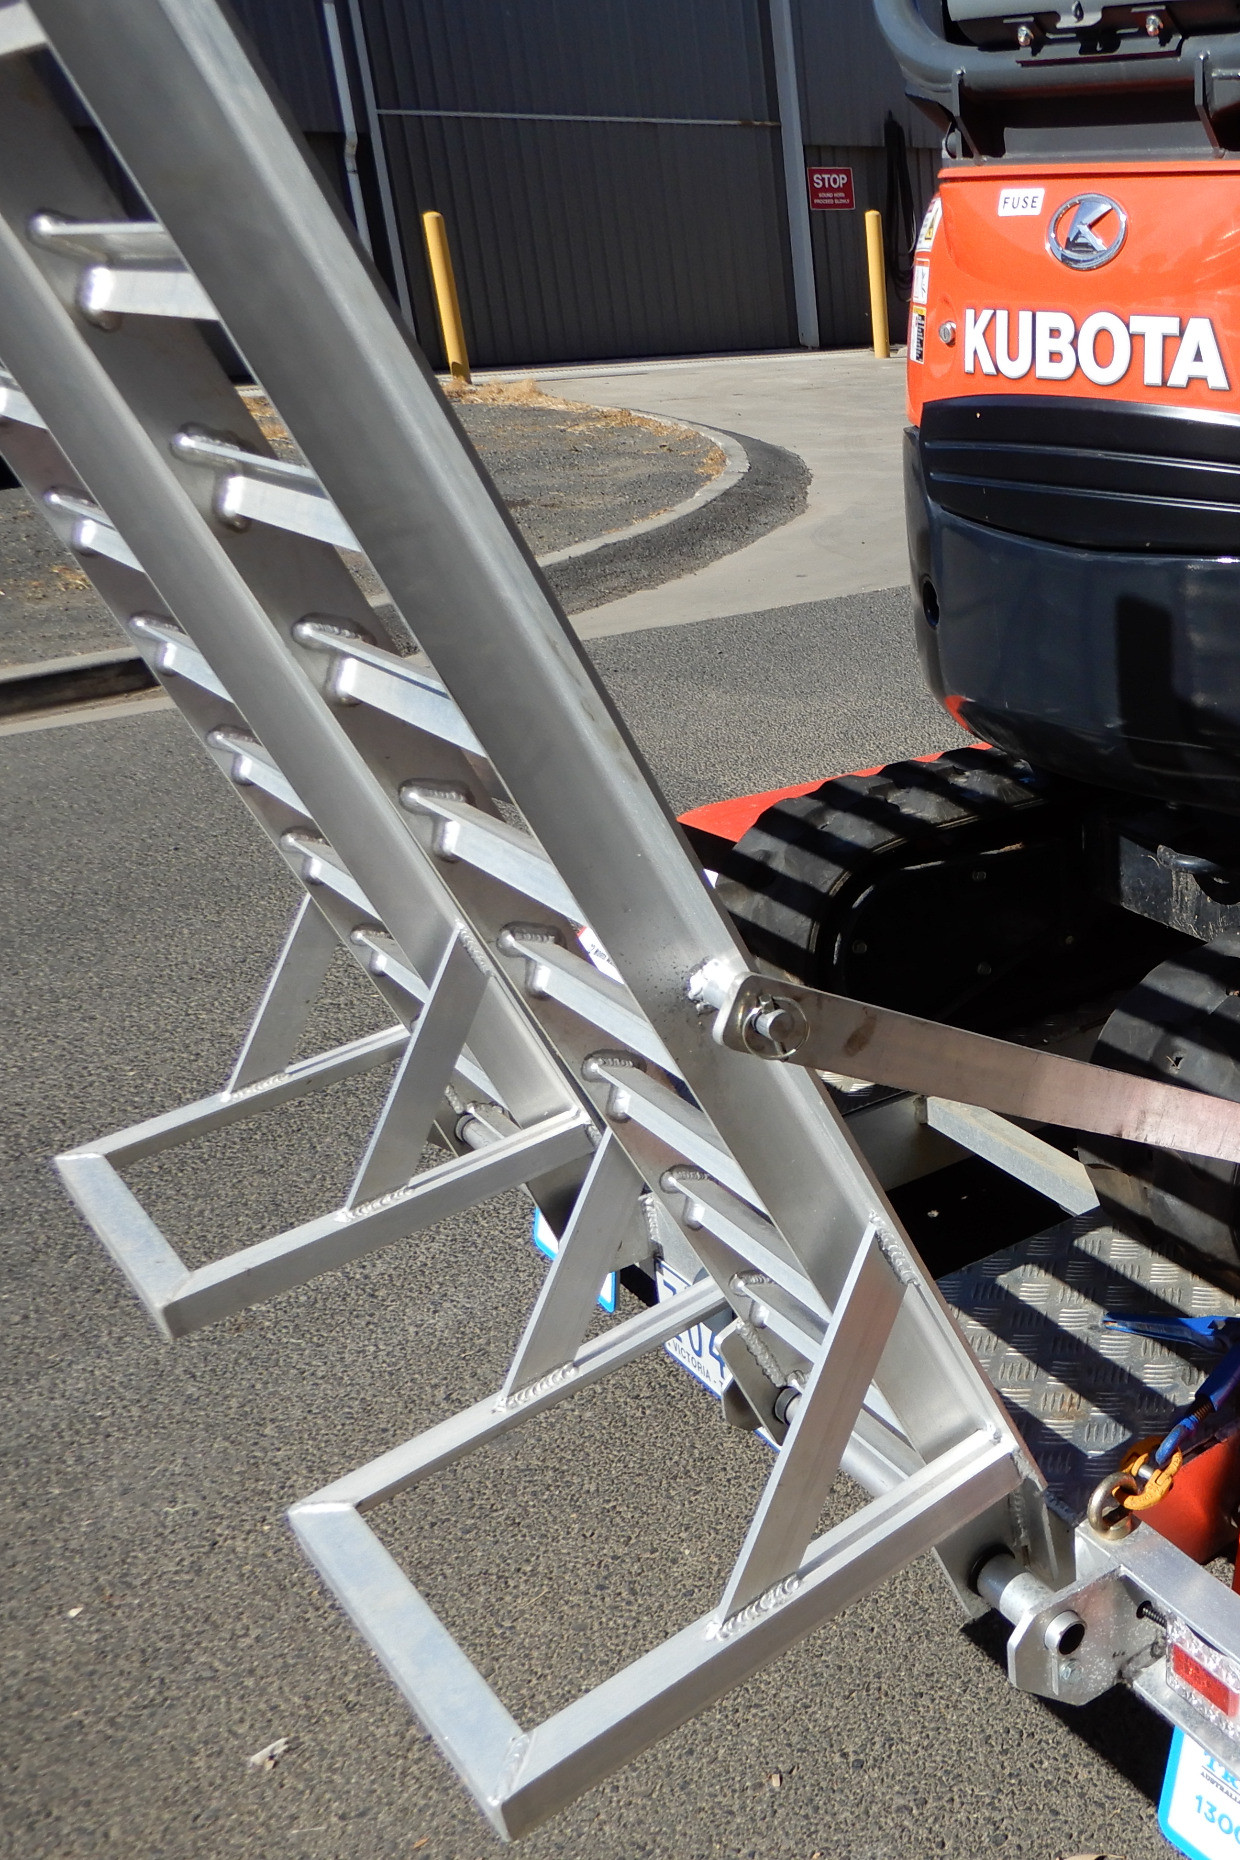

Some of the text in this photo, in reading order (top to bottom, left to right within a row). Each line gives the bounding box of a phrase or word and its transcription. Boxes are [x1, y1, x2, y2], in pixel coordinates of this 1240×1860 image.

[813, 174, 848, 188] STOP
[1002, 196, 1039, 209] FUSE
[964, 308, 1231, 390] KUBOTA
[672, 1341, 711, 1380] VICTORIA
